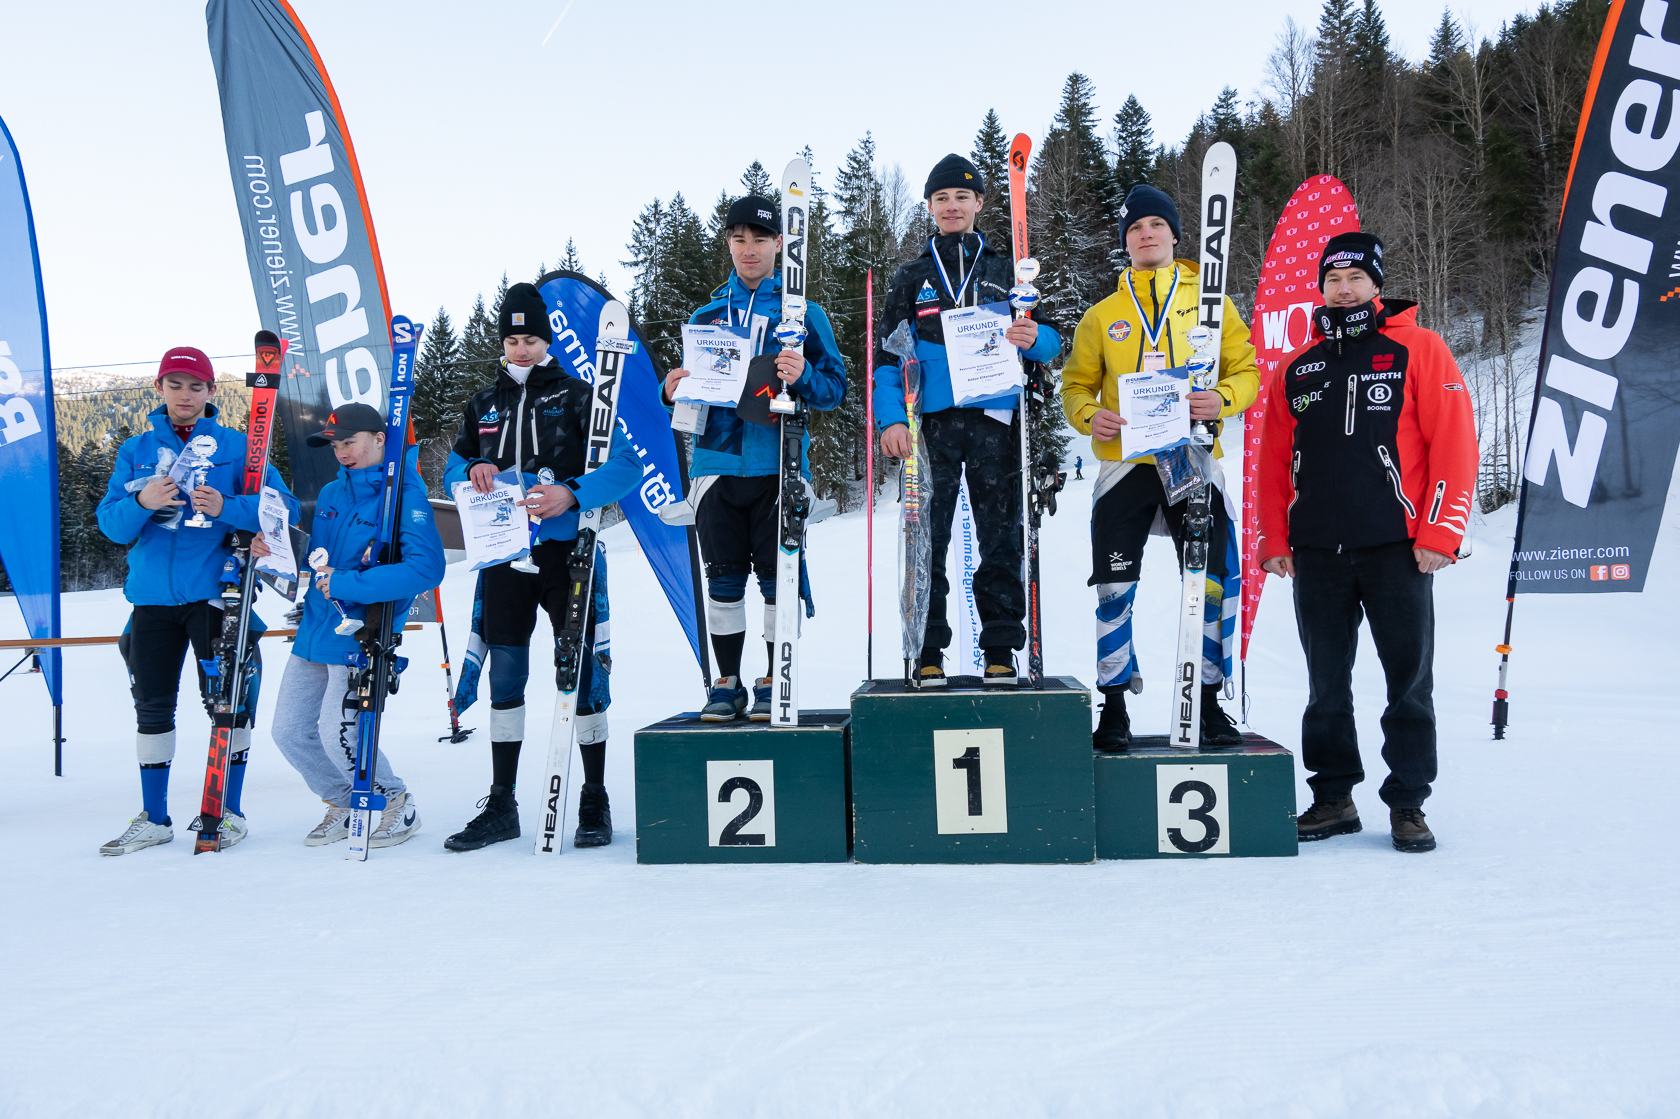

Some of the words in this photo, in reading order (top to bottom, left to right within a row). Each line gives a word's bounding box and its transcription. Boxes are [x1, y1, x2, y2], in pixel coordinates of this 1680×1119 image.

[787, 206, 805, 297] EAD
[1201, 194, 1227, 329] HEAD
[1323, 250, 1365, 266] Actimel
[917, 289, 937, 302] ASV
[957, 320, 999, 333] URKUNDE
[1262, 302, 1323, 353] WO
[696, 339, 738, 348] URKUNDE
[587, 350, 620, 470] HEAD
[1133, 384, 1176, 395] URKUNDE
[250, 398, 268, 473] ROSSIGNOL
[470, 490, 509, 504] URKUNDE
[1509, 569, 1551, 580] FOLLOW
[1553, 569, 1568, 579] US
[1571, 568, 1586, 579] ON
[1511, 546, 1630, 562] www.ziener.com
[780, 641, 792, 722] HEAD
[1179, 661, 1194, 743] HEAD
[542, 774, 562, 852] HEAD
[717, 777, 766, 845] 2
[952, 746, 982, 816] 1
[1166, 780, 1220, 853] 3
